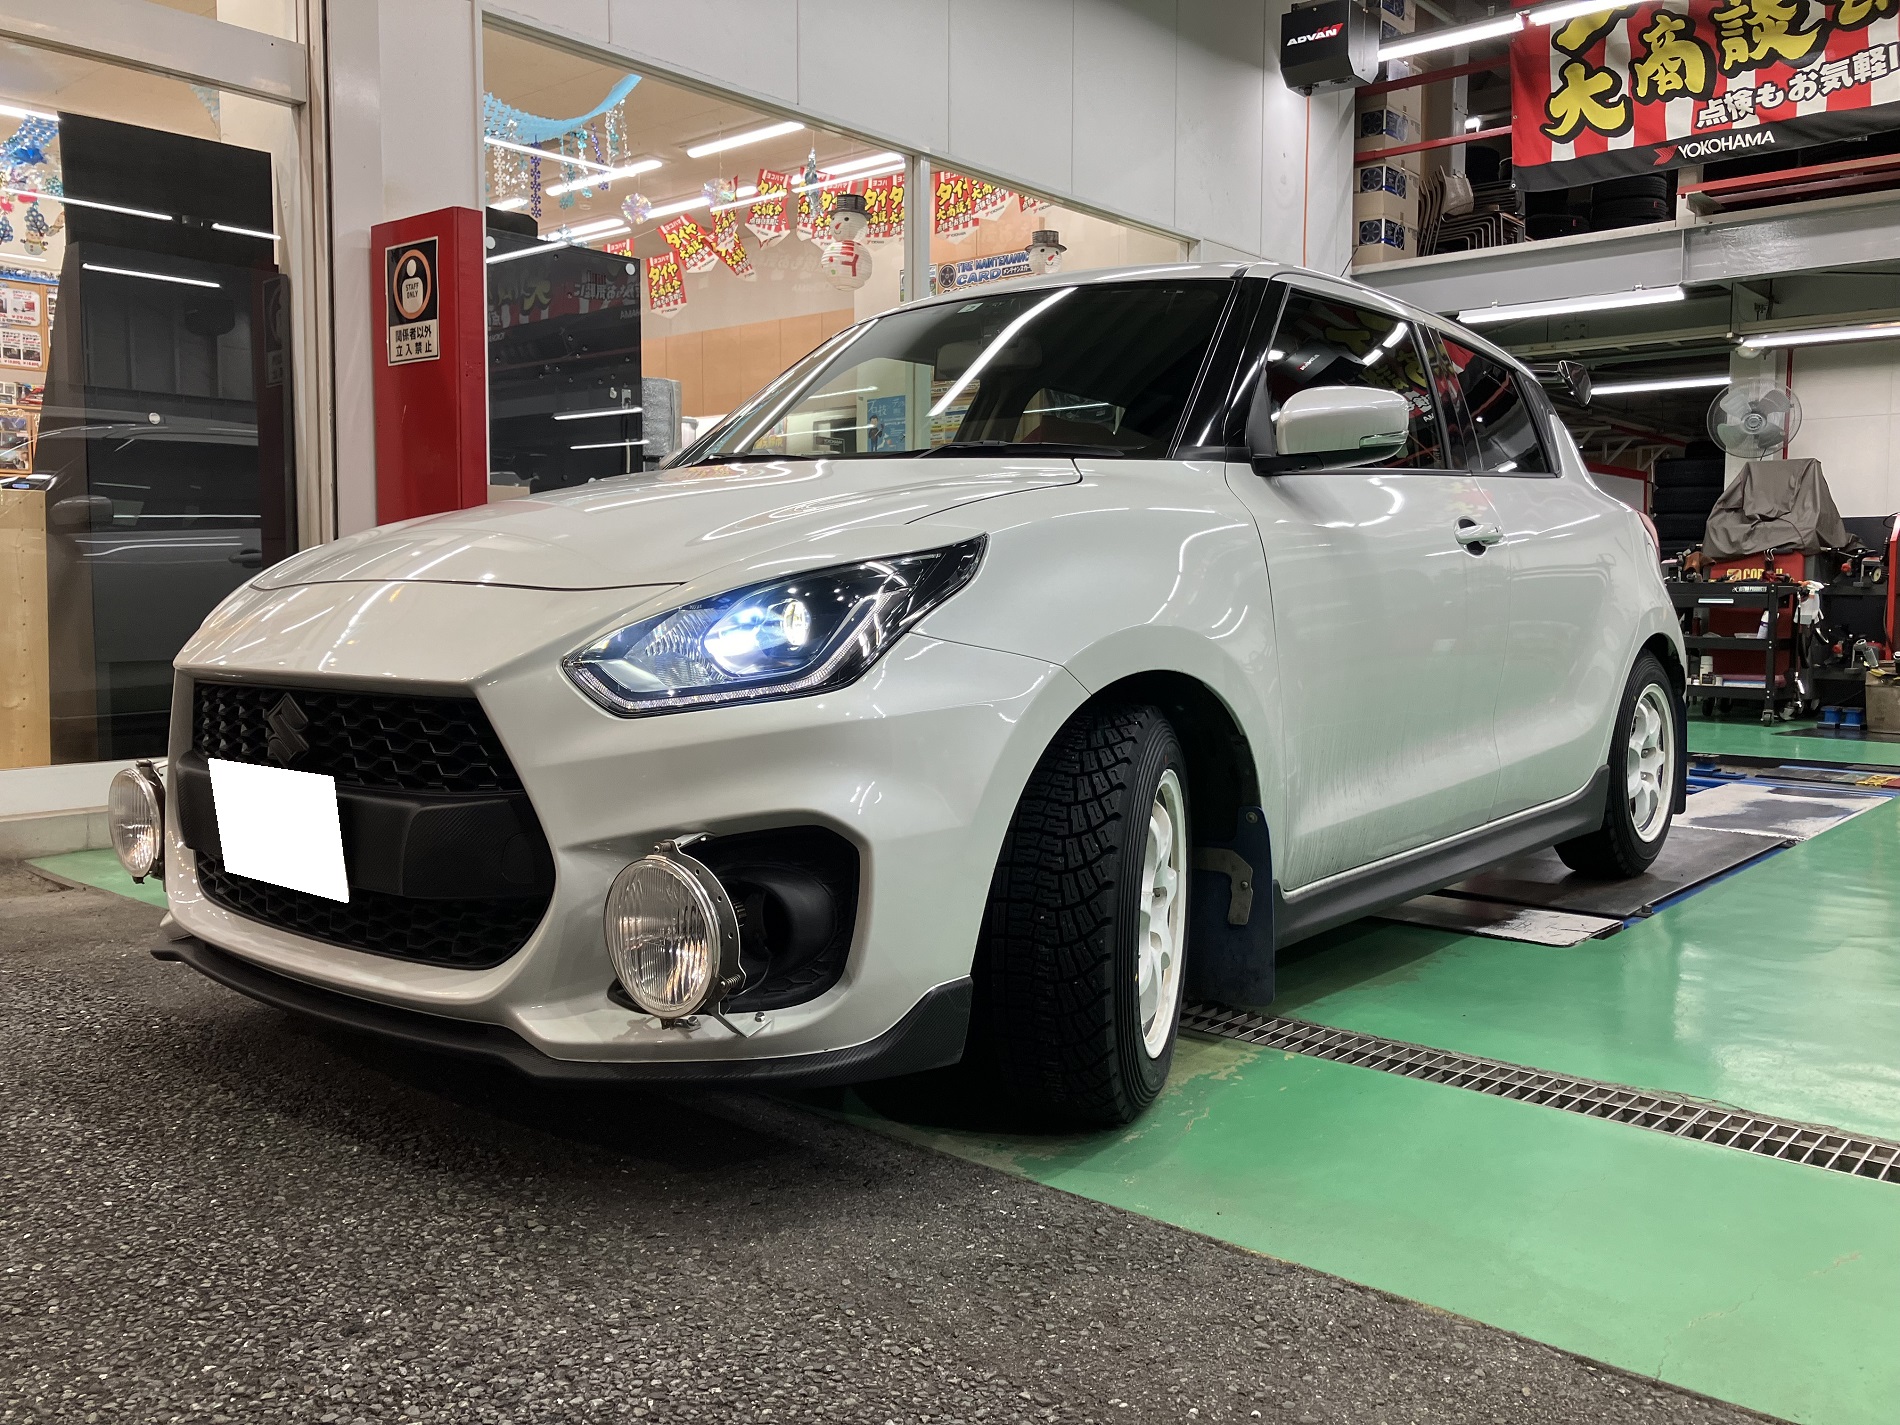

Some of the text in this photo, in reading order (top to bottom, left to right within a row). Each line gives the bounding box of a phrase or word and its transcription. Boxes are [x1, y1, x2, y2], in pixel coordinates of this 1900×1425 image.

[1287, 28, 1338, 46] ADVAN
[1677, 130, 1775, 159] YOKOHAMA
[665, 223, 697, 248] タイヤ
[648, 262, 678, 286] タイヤ
[956, 268, 1001, 285] CARD
[405, 282, 420, 292] STAFF
[406, 290, 419, 299] ONLY
[395, 324, 432, 342] 関係者以外
[395, 340, 433, 358] 立入禁止
